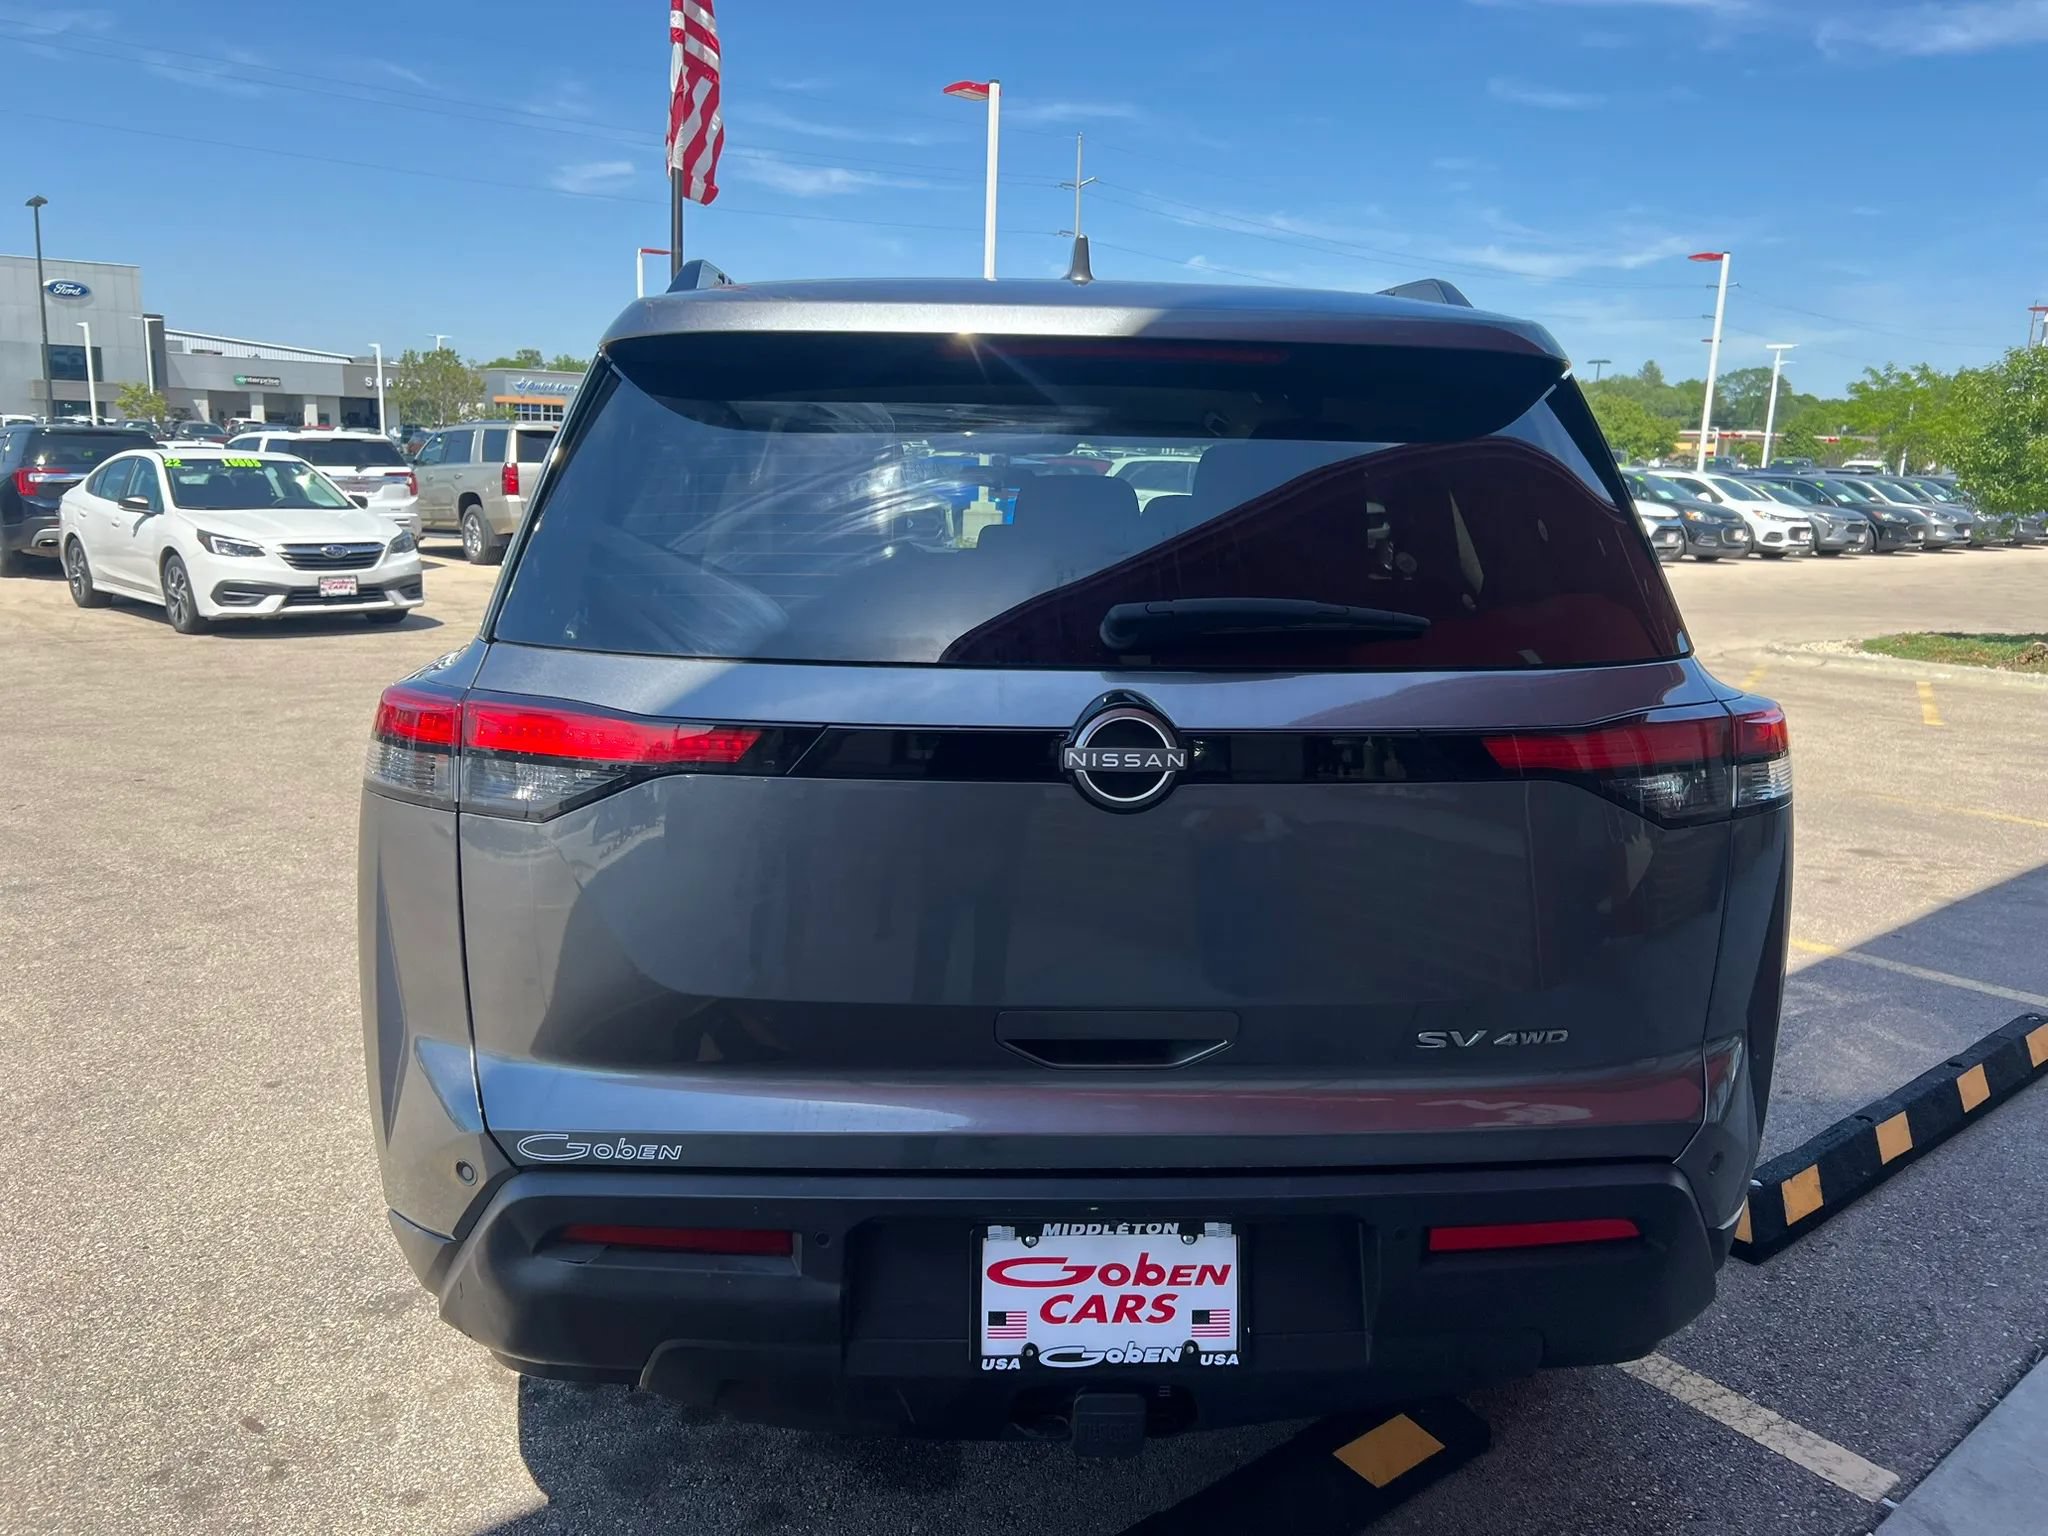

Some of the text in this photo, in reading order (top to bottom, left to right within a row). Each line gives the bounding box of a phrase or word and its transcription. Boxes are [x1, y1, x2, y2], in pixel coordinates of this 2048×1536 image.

[53, 283, 81, 296] Ford
[528, 381, 556, 391] Quick
[164, 459, 181, 467] 22
[1068, 752, 1185, 768] NISSAN
[1416, 1029, 1569, 1048] SV 4WD
[1042, 1222, 1180, 1237] MIDDLETON
[1039, 1293, 1179, 1325] CARS
[981, 1357, 1022, 1370] USA
[1200, 1353, 1240, 1366] USA
